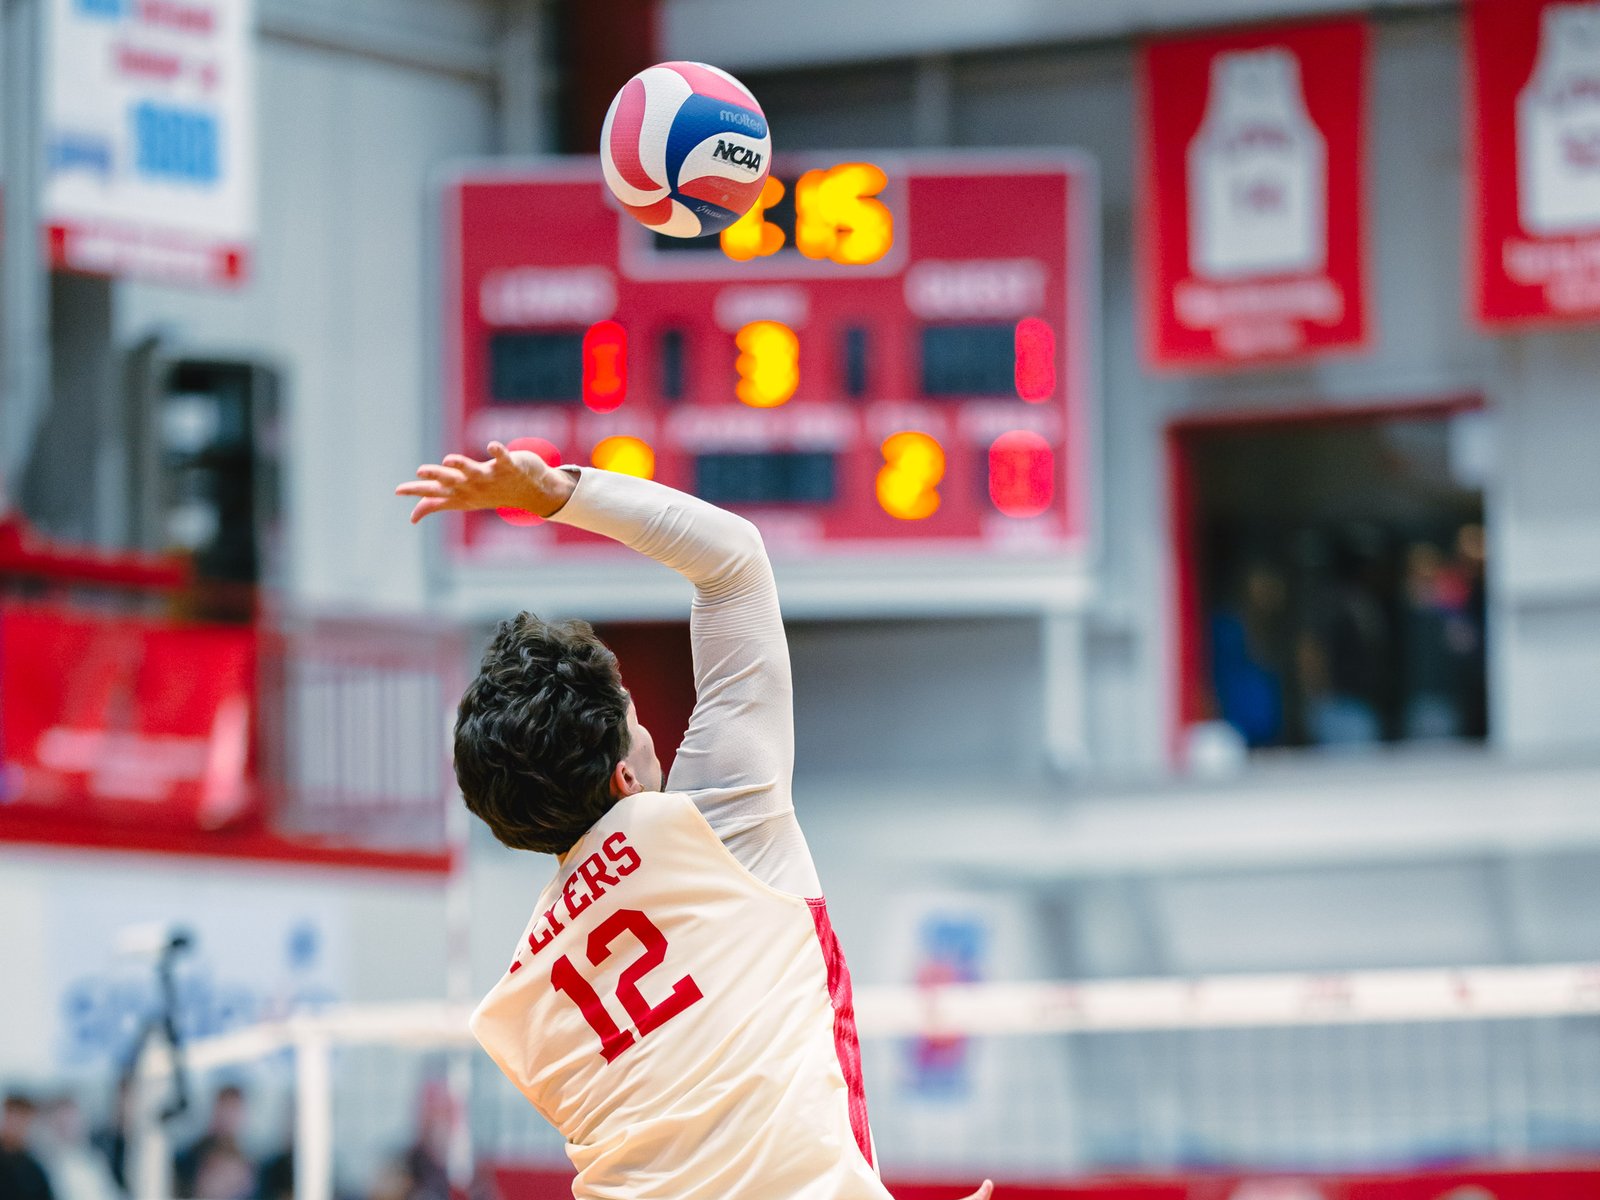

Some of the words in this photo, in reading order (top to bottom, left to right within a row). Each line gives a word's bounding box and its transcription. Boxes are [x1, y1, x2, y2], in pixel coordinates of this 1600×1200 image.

[712, 139, 761, 172] NCAA
[720, 109, 764, 133] molten
[509, 831, 642, 974] LYERS
[550, 908, 705, 1066] 12
